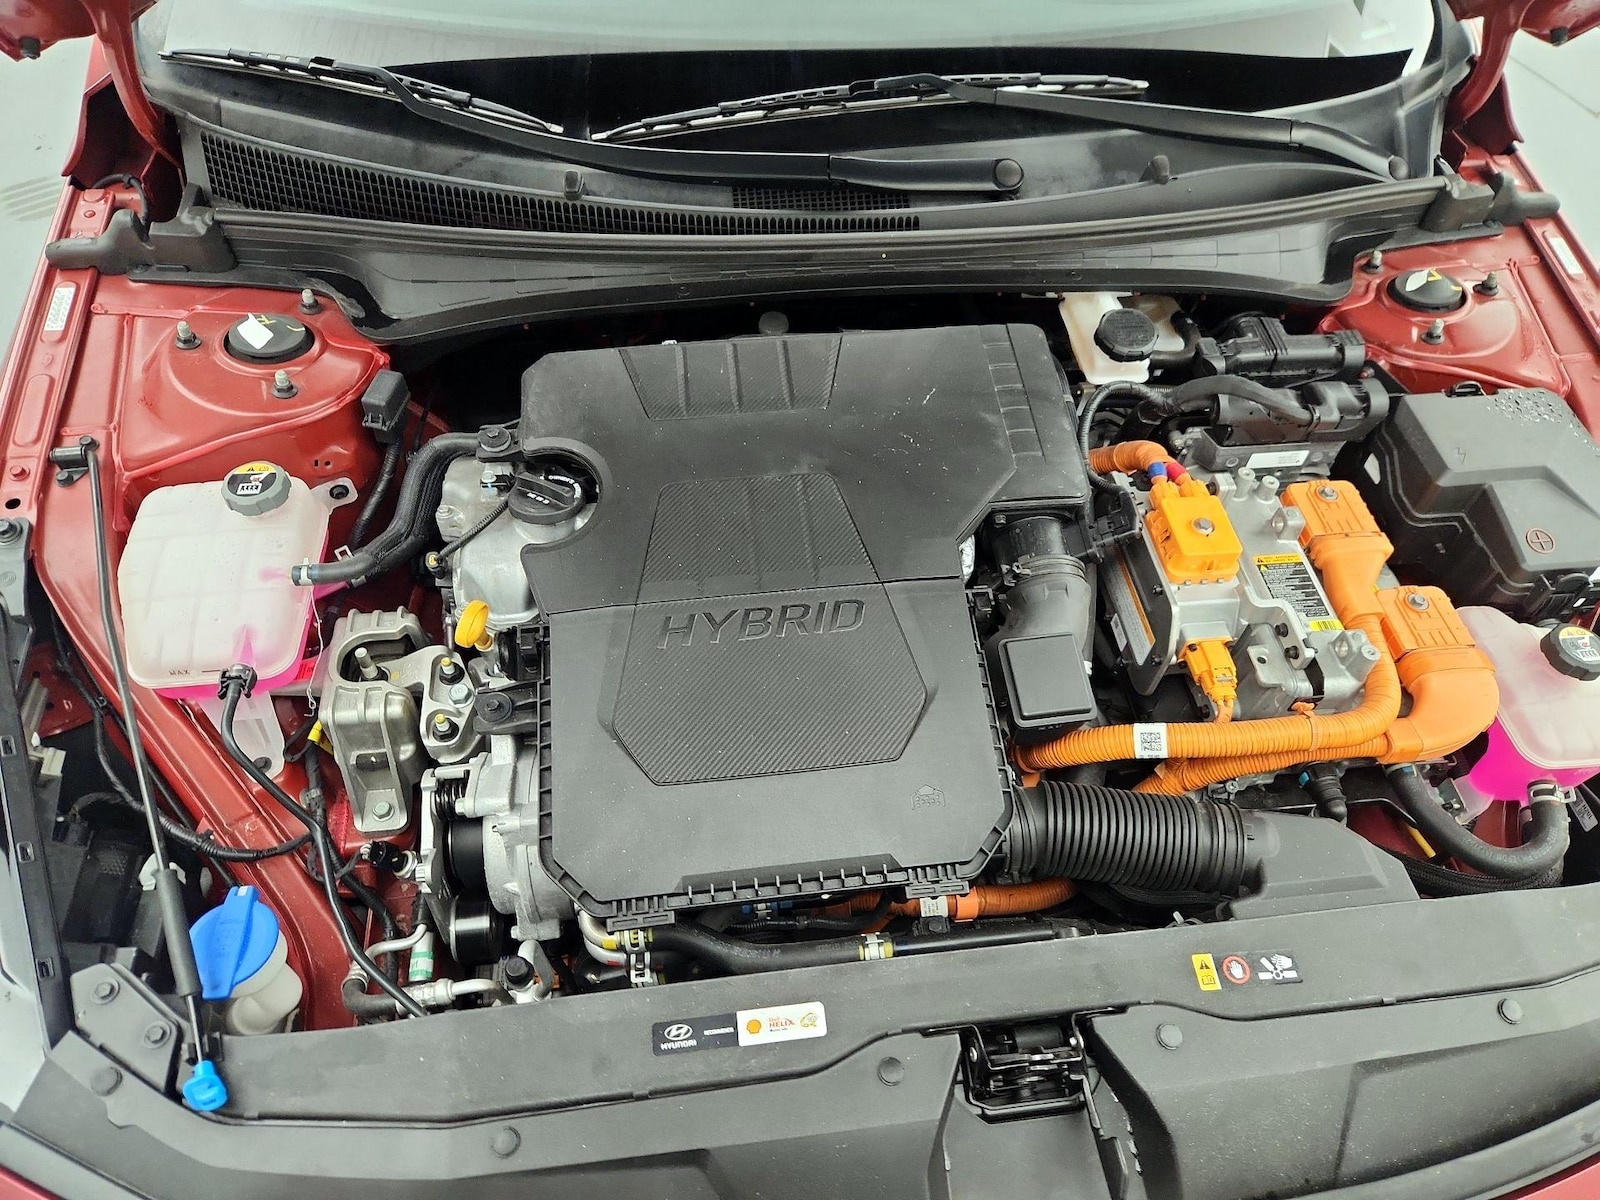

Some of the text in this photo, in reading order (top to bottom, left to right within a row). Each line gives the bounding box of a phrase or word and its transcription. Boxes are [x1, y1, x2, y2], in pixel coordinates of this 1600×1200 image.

[657, 599, 866, 649] HYBRID
[769, 1018, 795, 1028] HELIX
[660, 1040, 697, 1050] HYUNDAI
